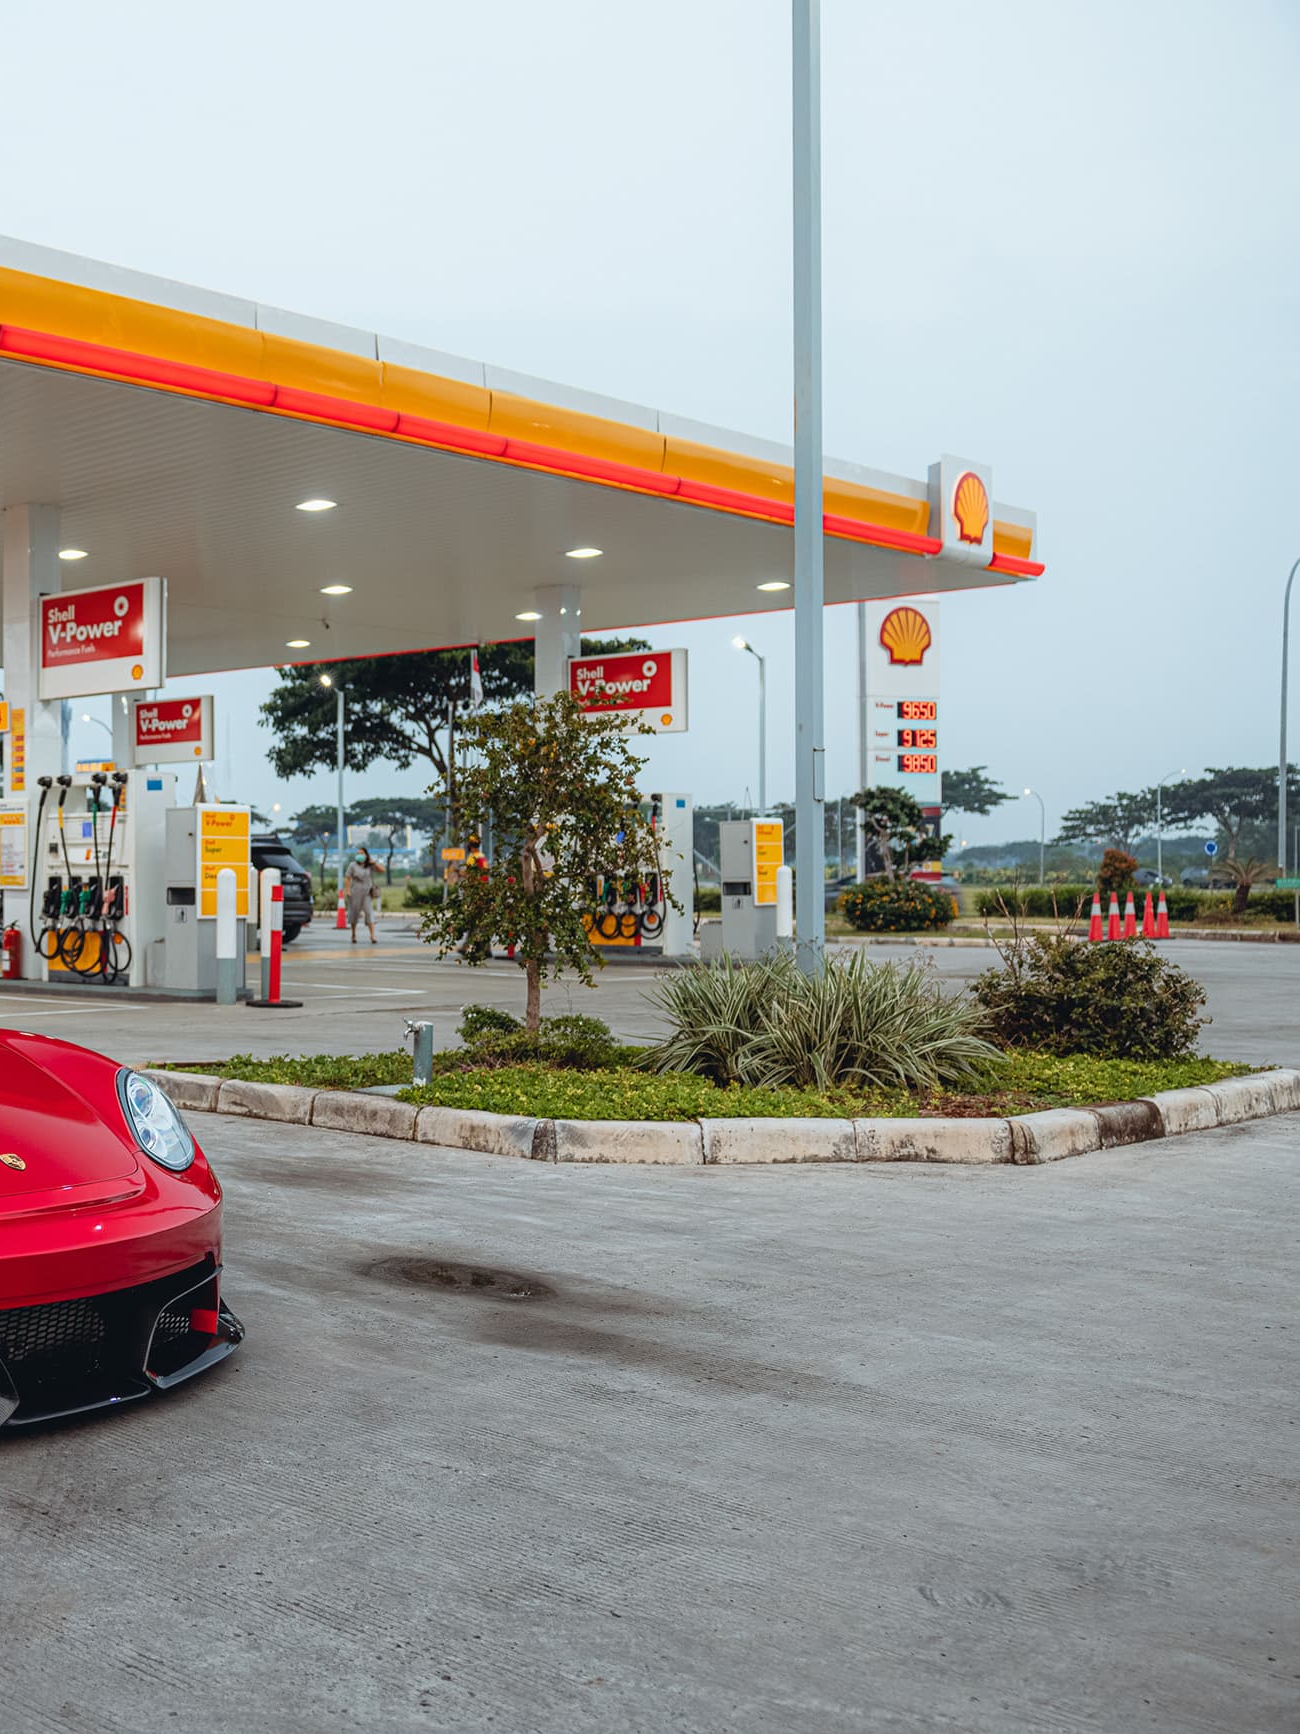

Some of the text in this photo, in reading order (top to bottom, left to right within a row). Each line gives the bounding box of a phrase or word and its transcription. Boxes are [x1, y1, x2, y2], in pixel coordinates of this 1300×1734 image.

[47, 605, 75, 623] Shell
[48, 620, 122, 645] V-Power
[577, 666, 604, 681] Shell
[577, 678, 651, 696] V-Power
[139, 708, 158, 719] Shell
[903, 701, 937, 719] 9650
[140, 719, 188, 733] V-Power
[903, 754, 937, 773] 9850
